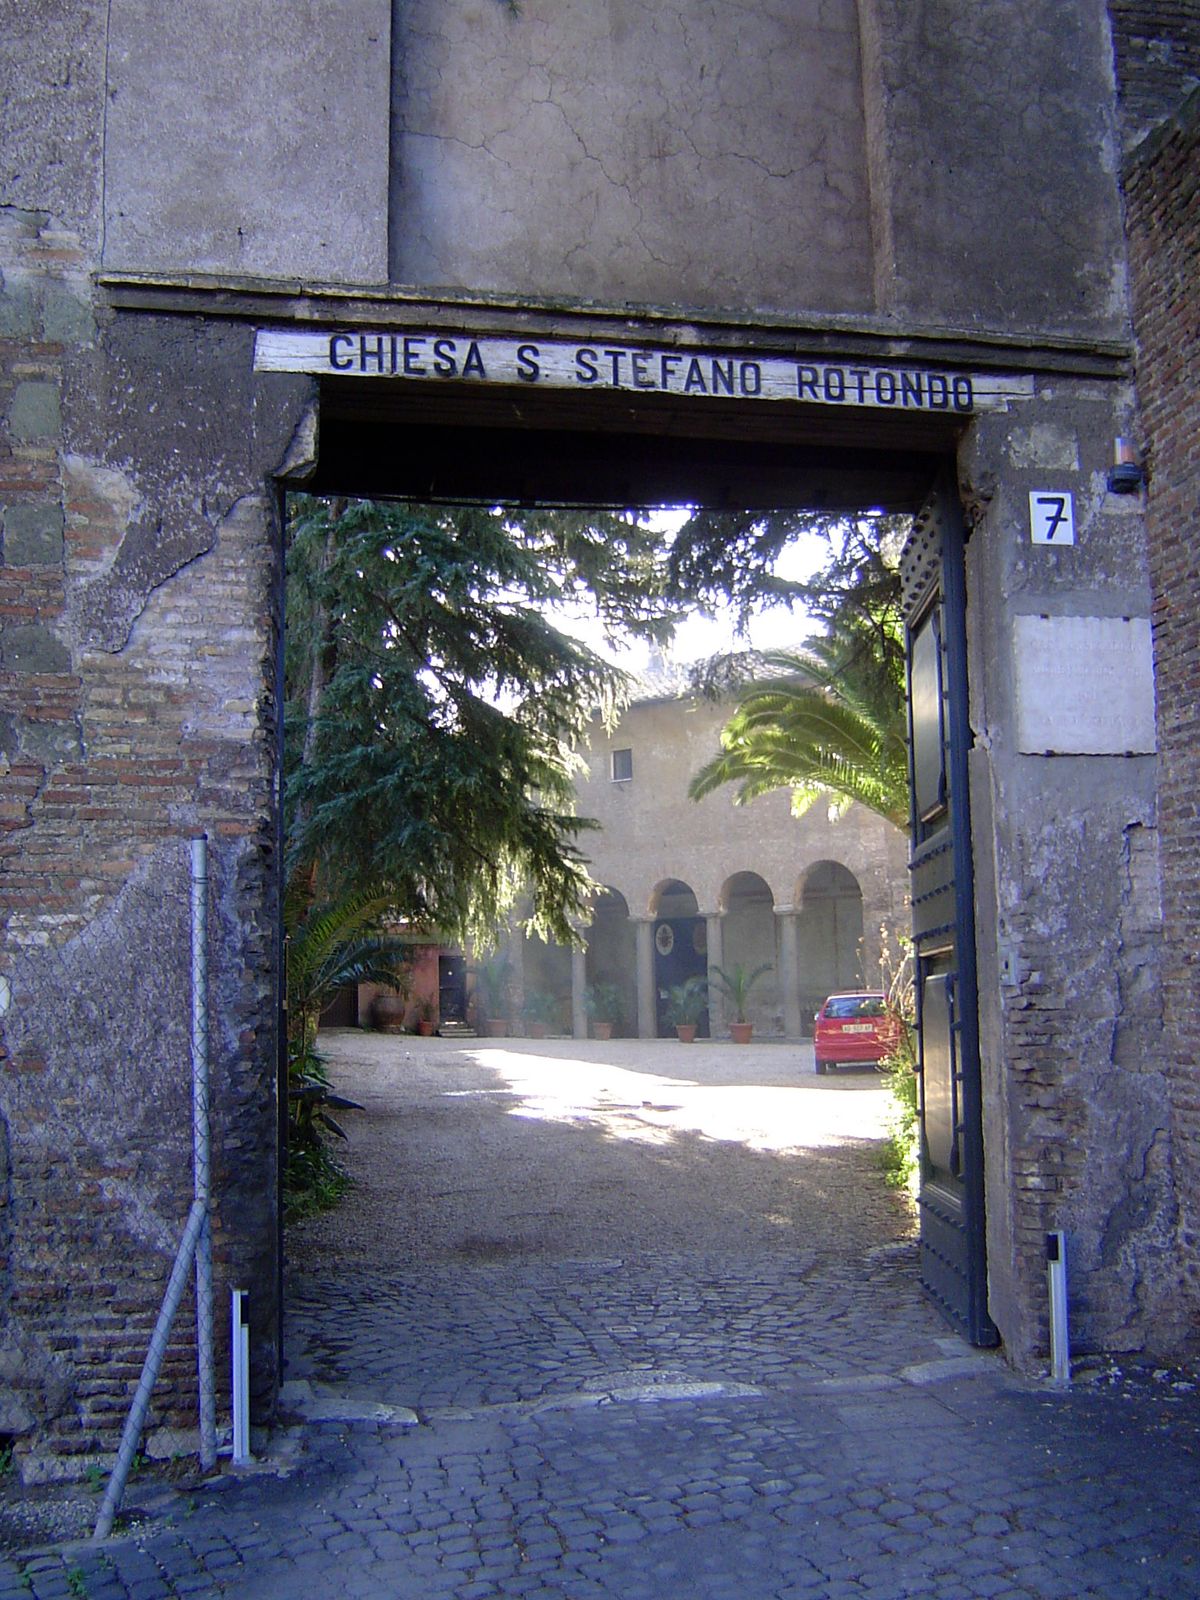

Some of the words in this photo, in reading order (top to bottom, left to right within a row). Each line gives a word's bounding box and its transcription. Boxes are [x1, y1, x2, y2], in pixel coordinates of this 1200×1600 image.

[328, 334, 486, 378] CHIESA
[575, 348, 763, 397] STEFANO
[797, 364, 974, 413] ROTONDO
[1036, 497, 1068, 540] 7
